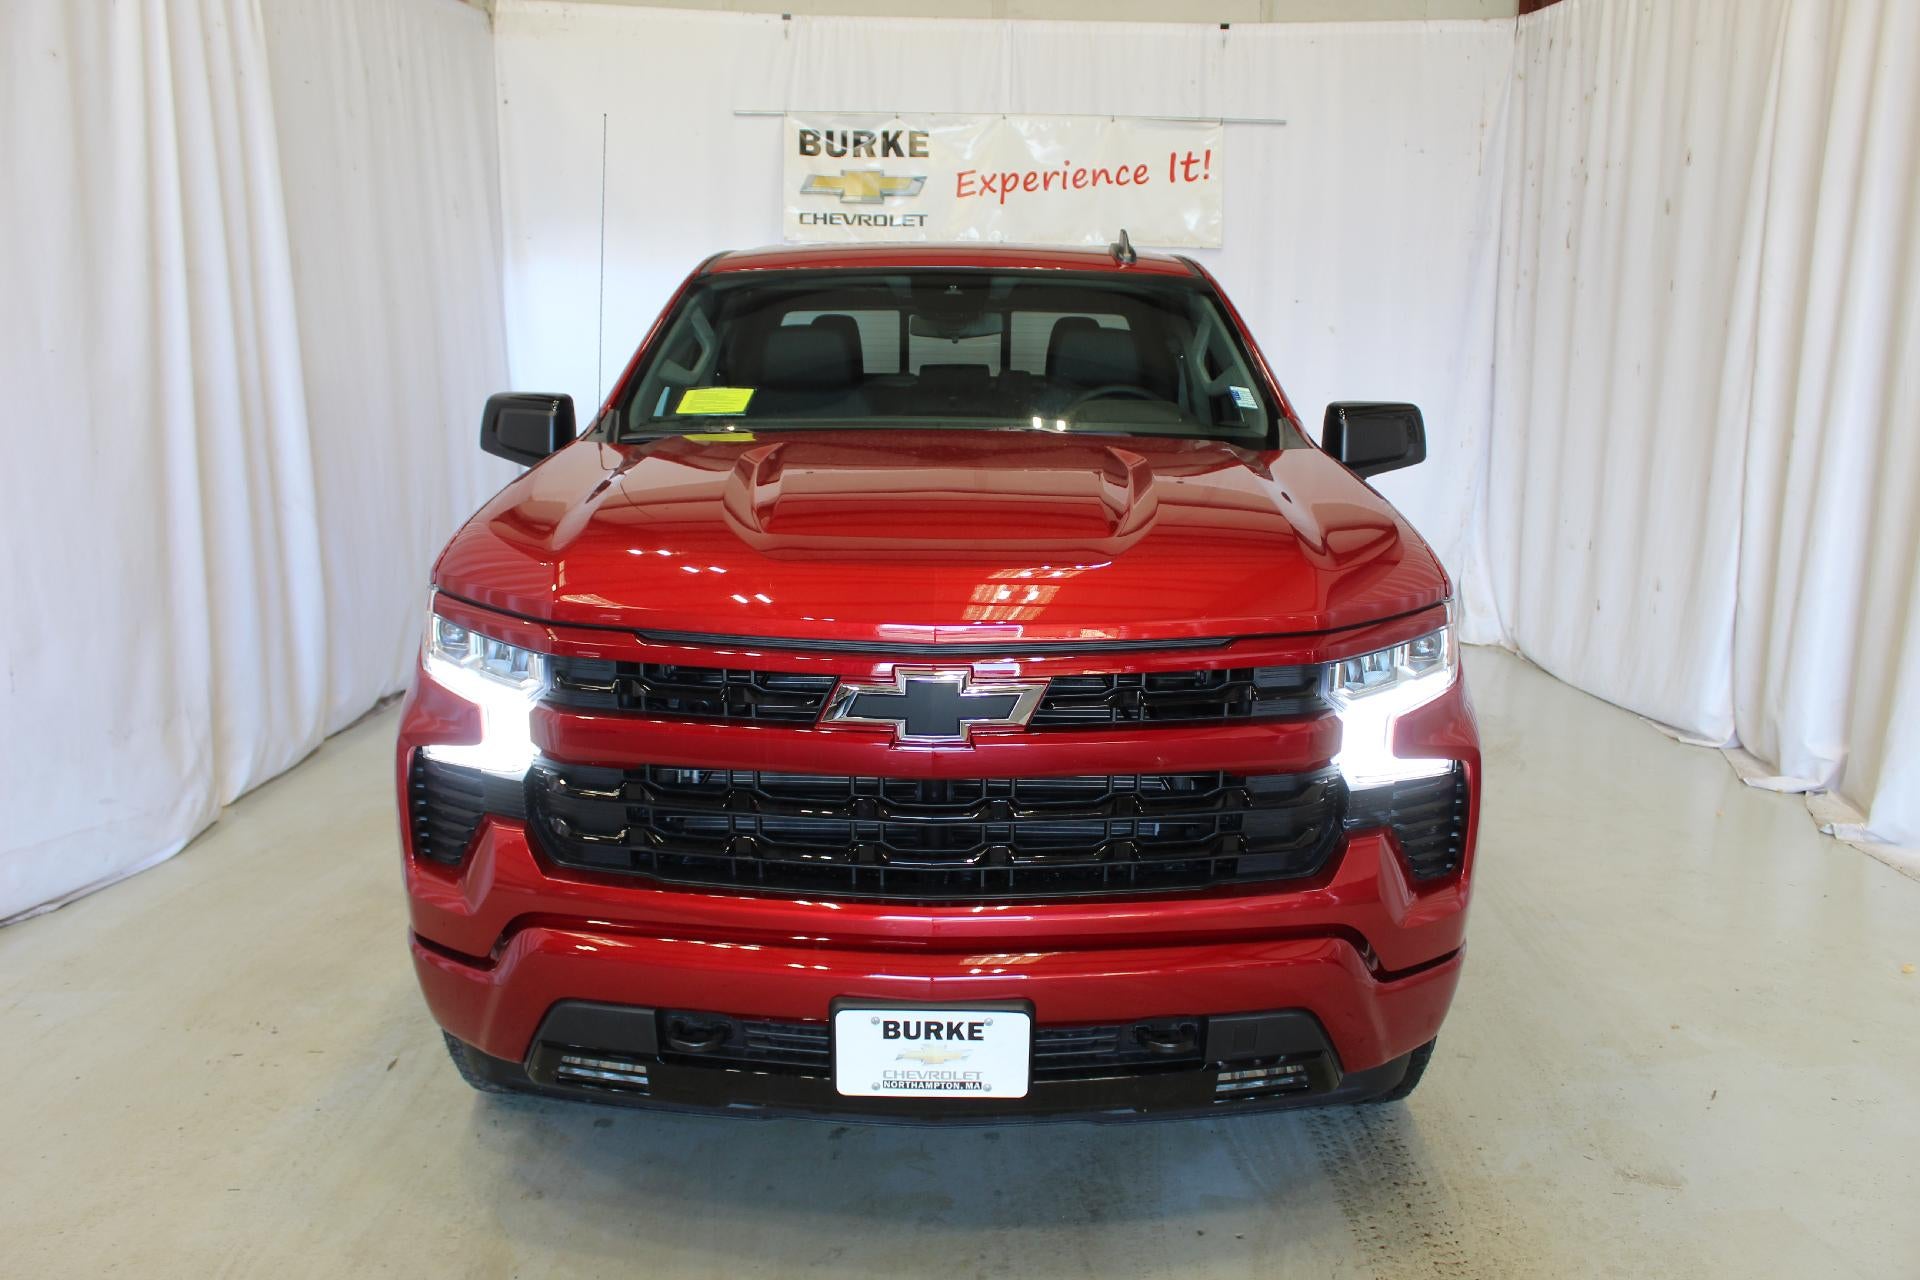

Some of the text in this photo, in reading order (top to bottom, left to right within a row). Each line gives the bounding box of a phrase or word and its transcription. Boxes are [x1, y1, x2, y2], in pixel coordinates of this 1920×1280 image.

[799, 129, 930, 158] BURKE
[955, 149, 1212, 205] Experience It!
[799, 212, 929, 228] CHEVROLET
[882, 1020, 985, 1041] BURKE
[882, 1069, 983, 1081] CHEVROLET
[965, 1081, 981, 1090] MA
